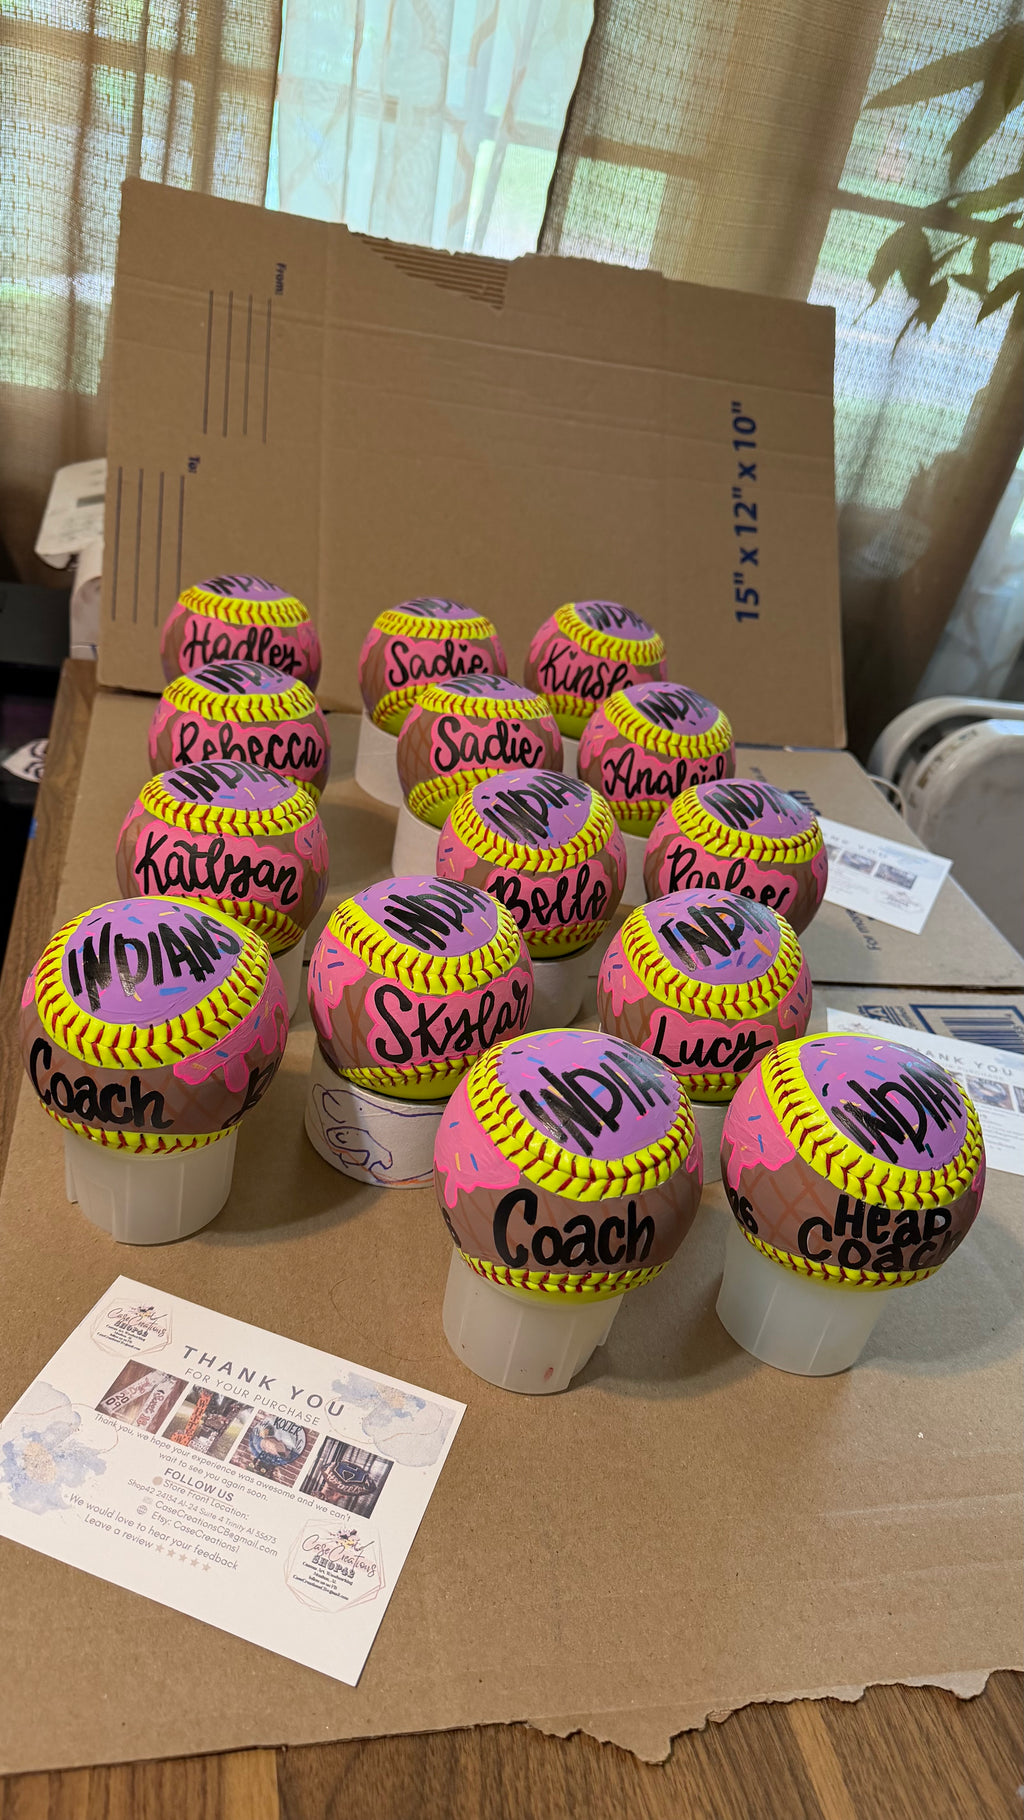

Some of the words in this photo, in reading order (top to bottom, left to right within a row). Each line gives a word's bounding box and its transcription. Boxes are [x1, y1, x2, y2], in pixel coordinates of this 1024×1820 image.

[275, 263, 287, 295] From:
[731, 401, 757, 451] 10"
[188, 457, 200, 474] To:
[738, 462, 757, 481] x
[731, 486, 759, 536] 12"
[739, 548, 759, 566] x
[733, 572, 760, 623] 15"
[182, 620, 302, 673] Hadley
[388, 640, 488, 687] Sadie
[175, 721, 322, 770] Rebecca
[434, 716, 543, 773] Sadie
[487, 864, 607, 930] Belle
[68, 912, 242, 1013] INDIANS
[374, 979, 529, 1064] Skylar
[652, 1015, 774, 1072] Lucy
[30, 1037, 175, 1129] Coach
[493, 1188, 656, 1268] Coach
[798, 1216, 964, 1273] Coach
[183, 1345, 277, 1391] THANK
[290, 1385, 345, 1417] YOU
[185, 1367, 211, 1384] FOR
[216, 1379, 250, 1398] YOUR
[253, 1394, 321, 1426] PURCHASE
[95, 1413, 117, 1428] Thank
[118, 1425, 135, 1437] you,
[137, 1433, 149, 1441] we
[150, 1435, 171, 1449] hope
[171, 1446, 191, 1457] your
[191, 1453, 236, 1476] experience
[238, 1472, 255, 1484] was
[256, 1480, 296, 1500] awesome
[297, 1496, 315, 1508] and
[315, 1504, 328, 1513] we
[329, 1510, 352, 1522] can't
[159, 1452, 178, 1465] wait
[179, 1460, 187, 1468] to
[188, 1464, 204, 1474] see
[204, 1470, 221, 1482] you
[221, 1478, 246, 1491] again
[163, 1467, 217, 1494] FOLLOW
[217, 1488, 235, 1502] US
[163, 1478, 186, 1495] Store
[187, 1490, 211, 1504] Front
[210, 1499, 250, 1521] Location:
[69, 1493, 84, 1506] We
[86, 1502, 116, 1519] would
[115, 1511, 135, 1527] love
[136, 1522, 147, 1532] to
[148, 1525, 171, 1541] hear
[171, 1537, 193, 1551] your
[193, 1545, 239, 1570] feedback
[84, 1513, 112, 1531] Leave
[122, 1530, 154, 1549] review
